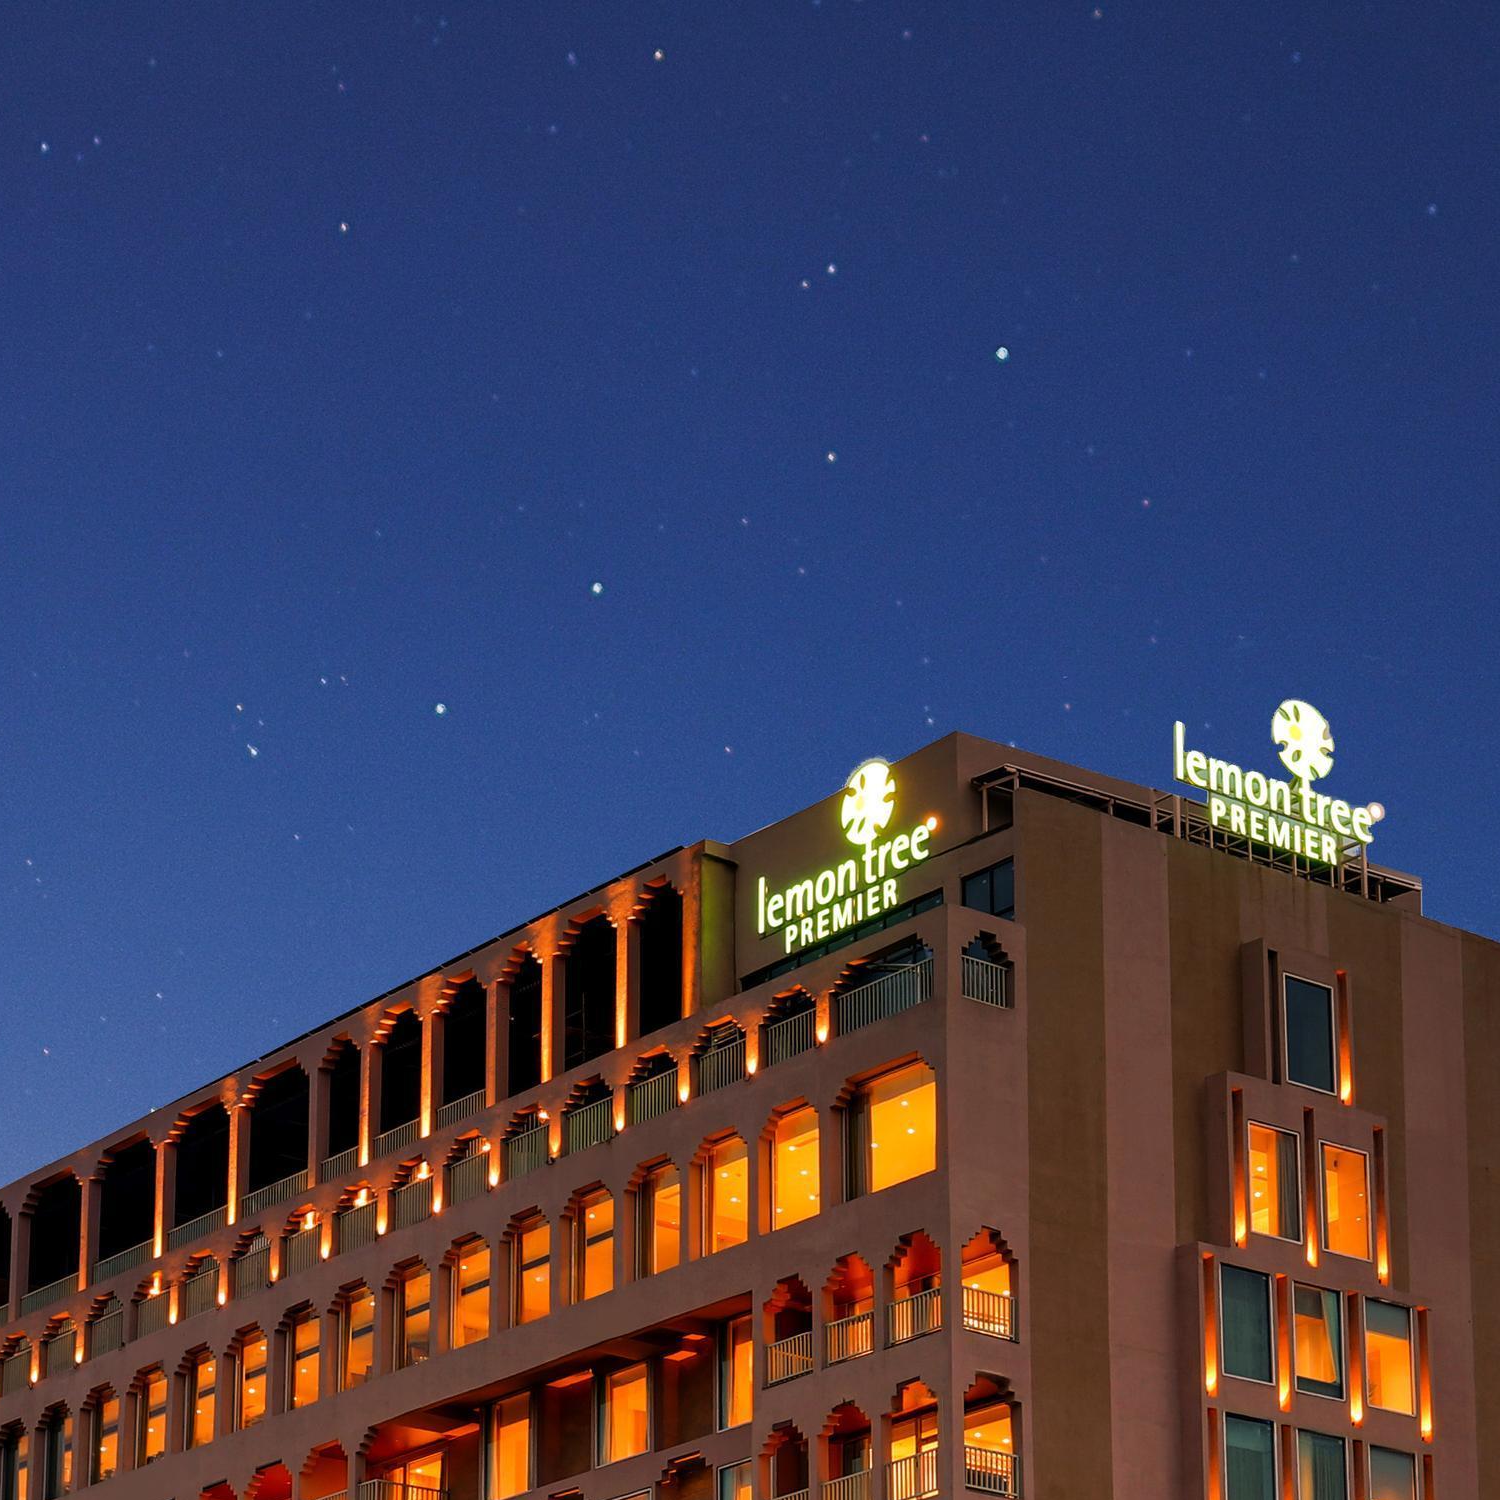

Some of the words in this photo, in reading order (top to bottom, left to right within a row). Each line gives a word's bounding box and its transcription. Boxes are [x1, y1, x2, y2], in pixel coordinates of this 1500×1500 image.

[1174, 720, 1292, 816] lemon
[1211, 797, 1337, 865] PREMIER
[758, 858, 857, 934] lemon
[785, 878, 897, 954] PREMIER
